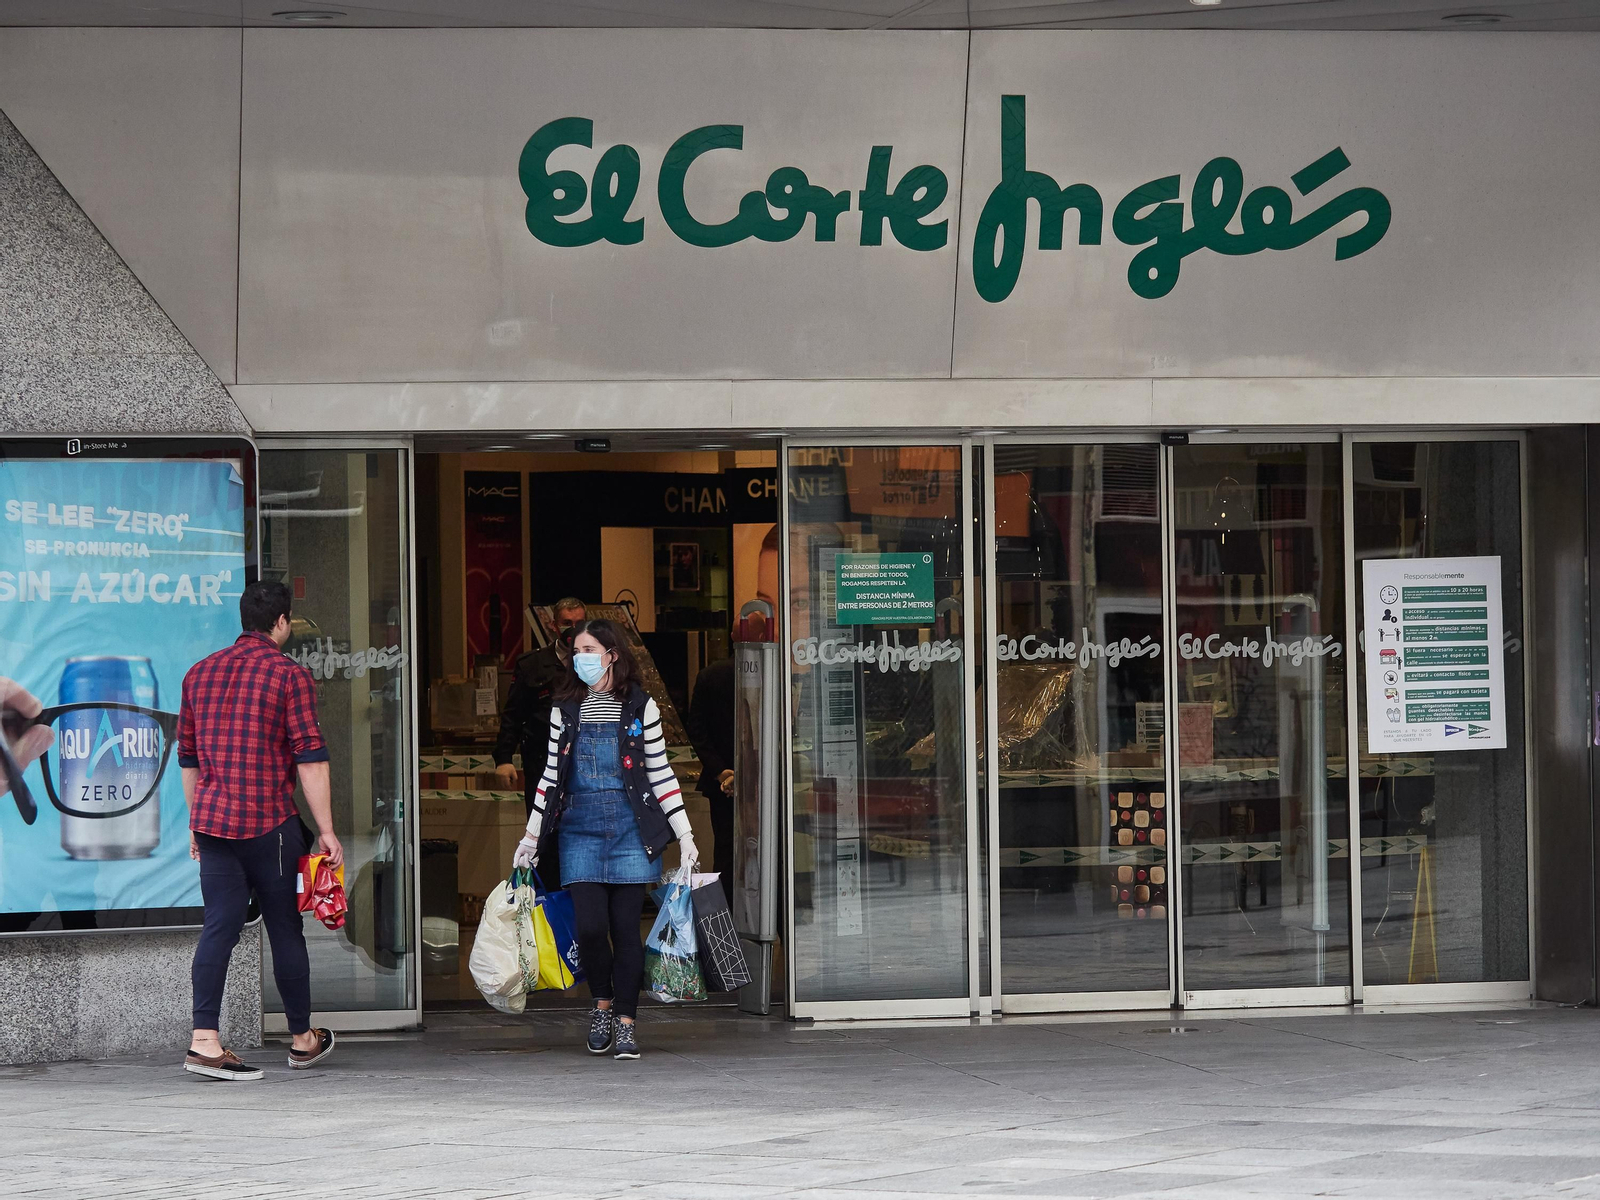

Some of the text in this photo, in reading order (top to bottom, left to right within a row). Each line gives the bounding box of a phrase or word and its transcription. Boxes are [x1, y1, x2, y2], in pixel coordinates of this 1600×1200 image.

[518, 94, 1393, 303] El Corte Inglés
[5, 500, 38, 525] SE
[47, 503, 94, 529] LEE
[25, 539, 151, 558] SE PRONUNCIA
[0, 571, 51, 603] SIN
[1403, 573, 1465, 581] Responsablemente
[324, 636, 409, 679] Inglés
[792, 630, 962, 673] El Corte Inglés
[996, 627, 1160, 668] El Corte Inglés
[1178, 632, 1203, 660] El
[1204, 634, 1260, 660] Corte
[1262, 626, 1342, 668] Inglés
[59, 709, 159, 779] AQUARIUS
[81, 784, 132, 801] ZERO
[126, 771, 148, 780] diaria
